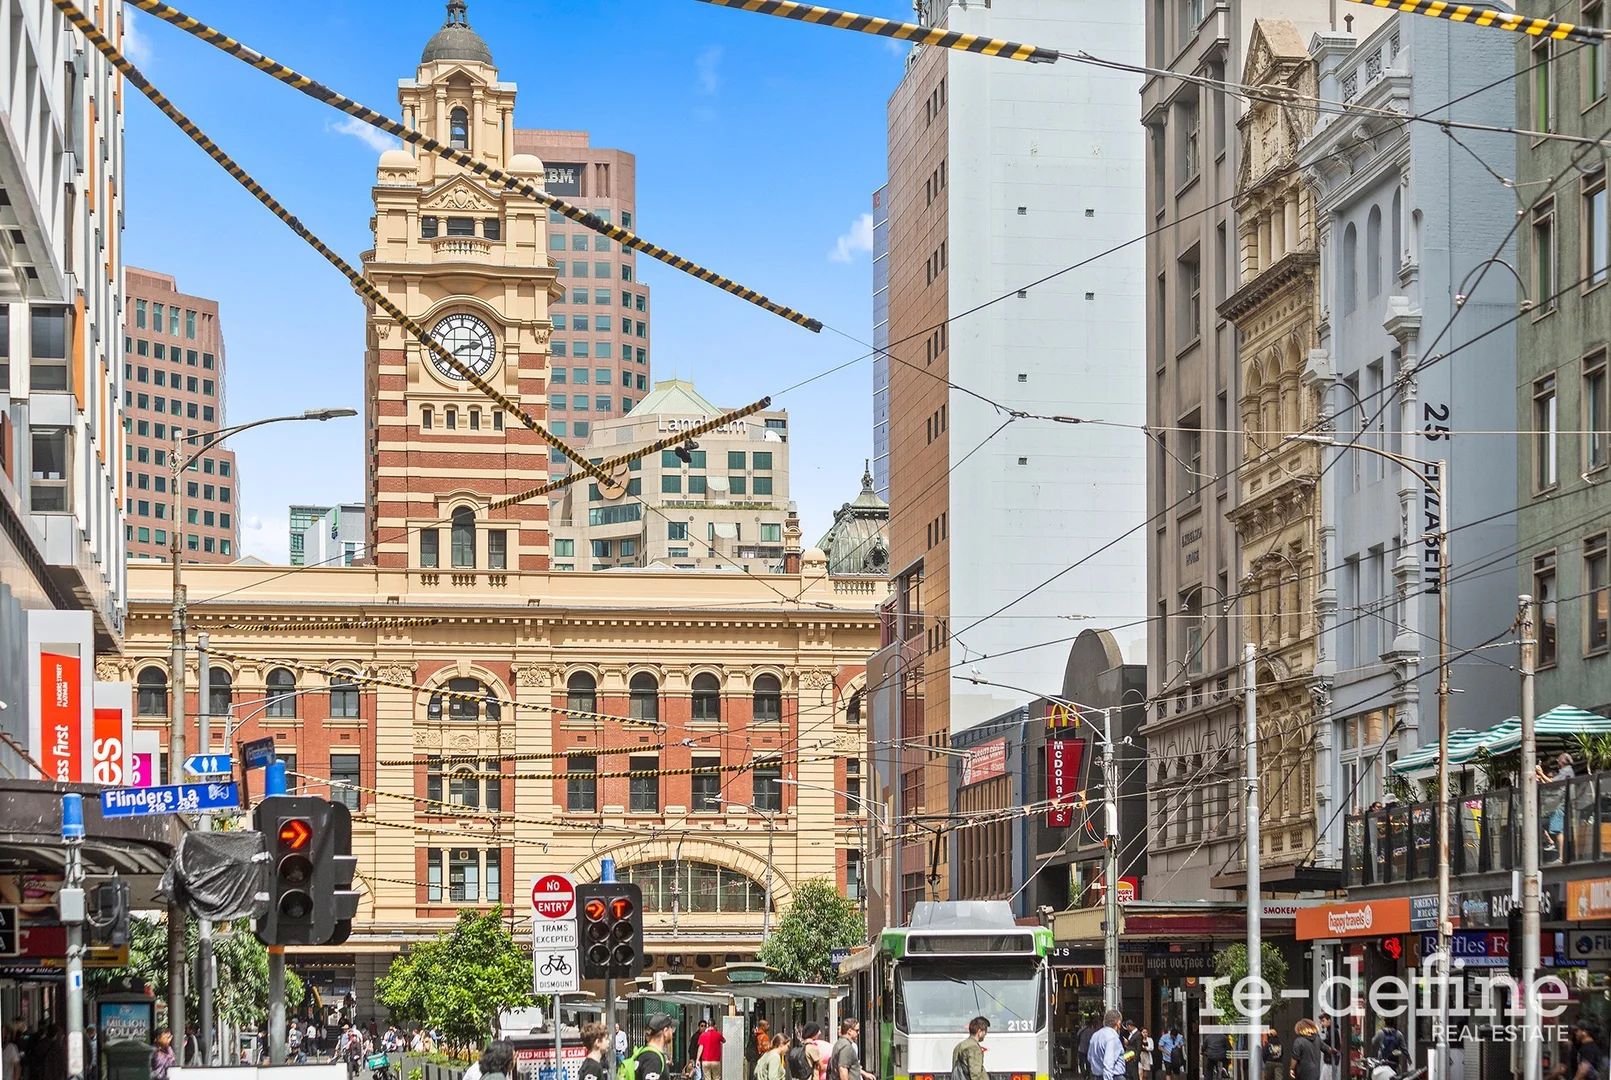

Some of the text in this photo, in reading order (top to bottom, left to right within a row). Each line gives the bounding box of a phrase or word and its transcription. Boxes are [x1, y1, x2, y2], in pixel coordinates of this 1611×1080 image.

[658, 414, 747, 432] Lanam
[1424, 402, 1450, 441] 25
[106, 789, 173, 808] Flinders
[547, 881, 560, 891] NO
[538, 902, 569, 913] ENTRY
[1263, 906, 1302, 915] SMOKEM
[541, 924, 568, 932] TRAMS
[536, 935, 575, 943] EXCEPTED
[1425, 935, 1485, 953] Rffles
[1147, 958, 1167, 969] HIGH
[1170, 956, 1204, 972] VOLTAGE
[539, 980, 573, 989] DISMOUNT
[105, 1019, 146, 1028] MILLION
[1007, 1019, 1034, 1032] 2131
[518, 1051, 533, 1059] KEEP
